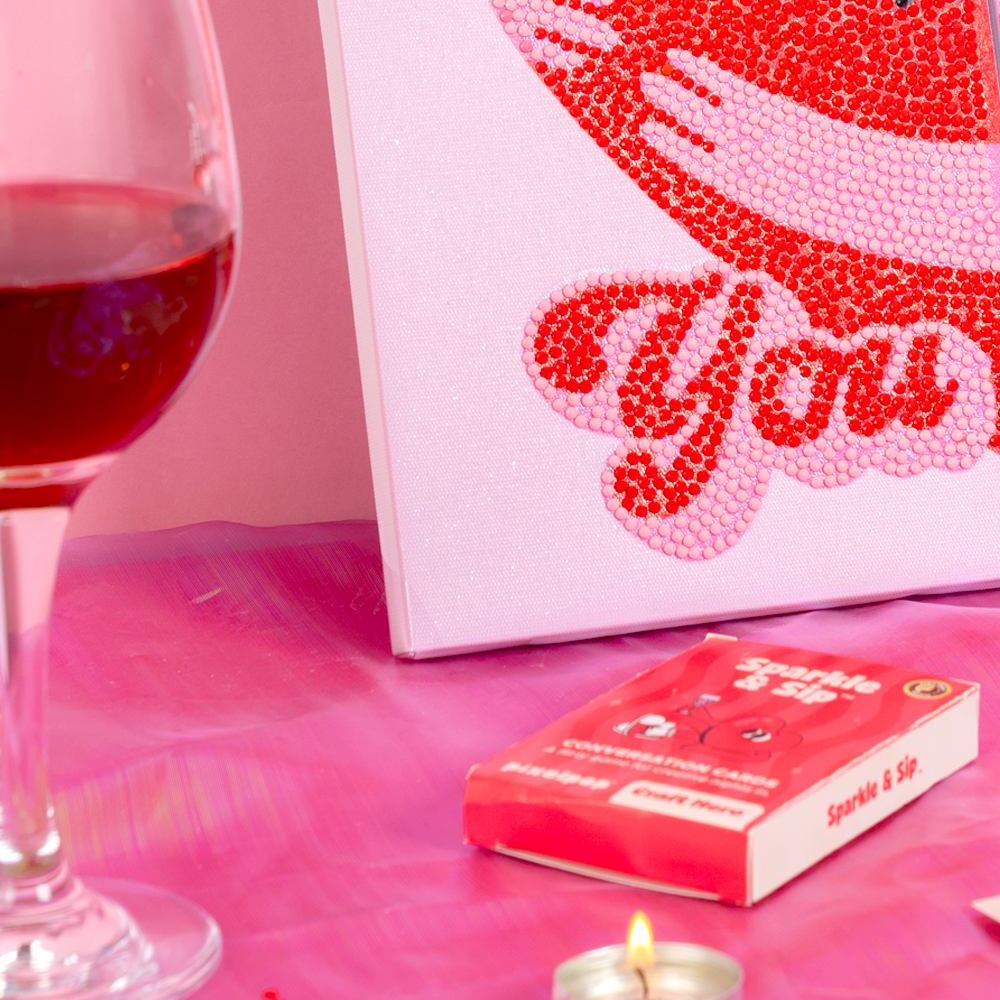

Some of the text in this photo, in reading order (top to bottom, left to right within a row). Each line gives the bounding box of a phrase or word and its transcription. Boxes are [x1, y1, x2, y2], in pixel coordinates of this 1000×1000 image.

[528, 270, 964, 522] You
[733, 674, 770, 692] &
[735, 657, 882, 695] Sparkle
[562, 738, 780, 789] CONVERSATION CARDS
[632, 787, 689, 805] Craft
[827, 780, 878, 828] Sparkle
[882, 768, 893, 791] &
